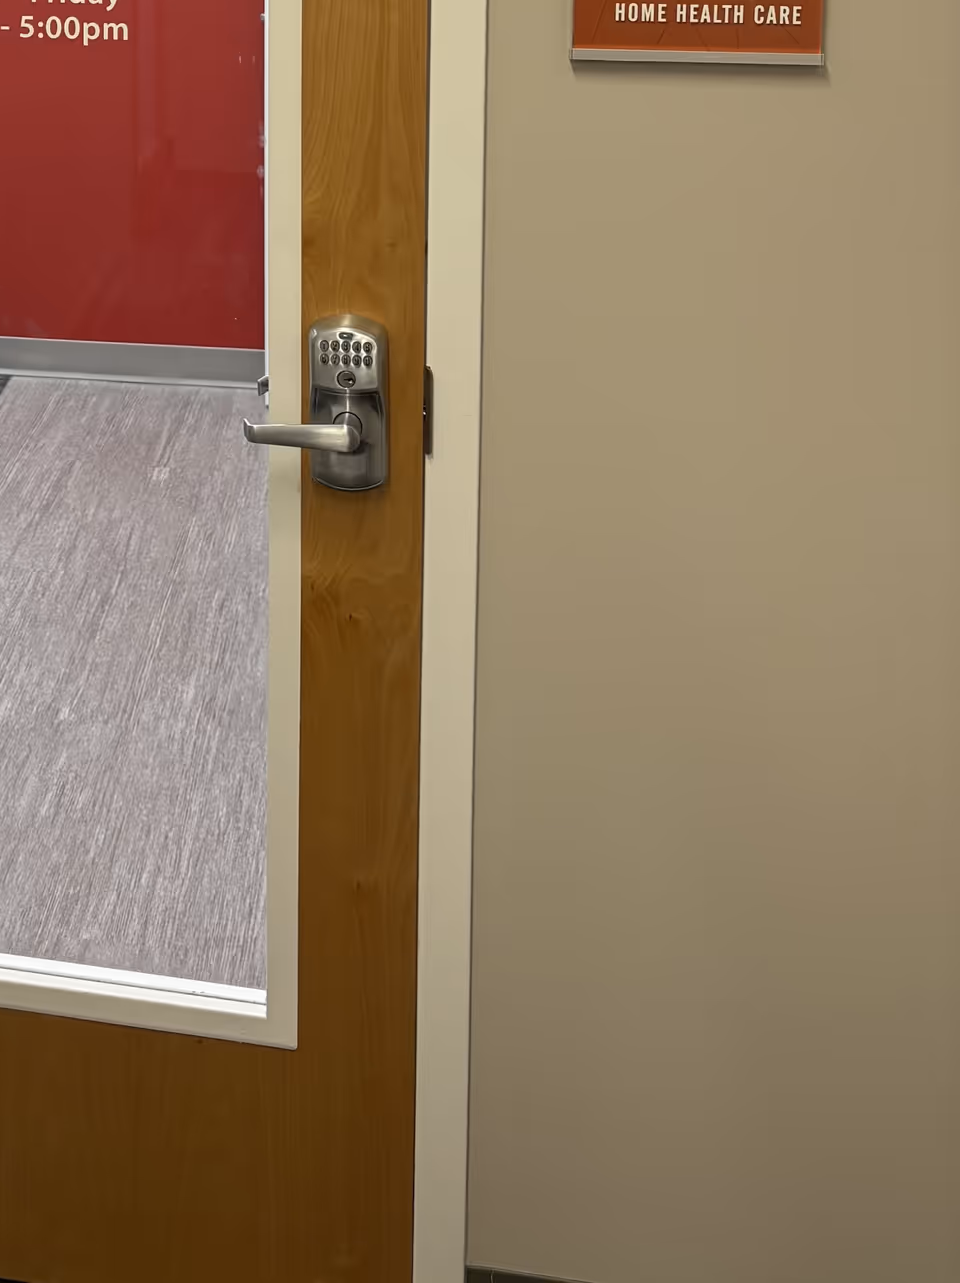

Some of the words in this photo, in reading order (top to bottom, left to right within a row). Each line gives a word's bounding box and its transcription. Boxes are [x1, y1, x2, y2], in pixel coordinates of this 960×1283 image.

[615, 2, 667, 23] HOME
[676, 4, 744, 24] HEALTH
[754, 5, 802, 25] CARE
[19, 16, 129, 46] 5:00pm
